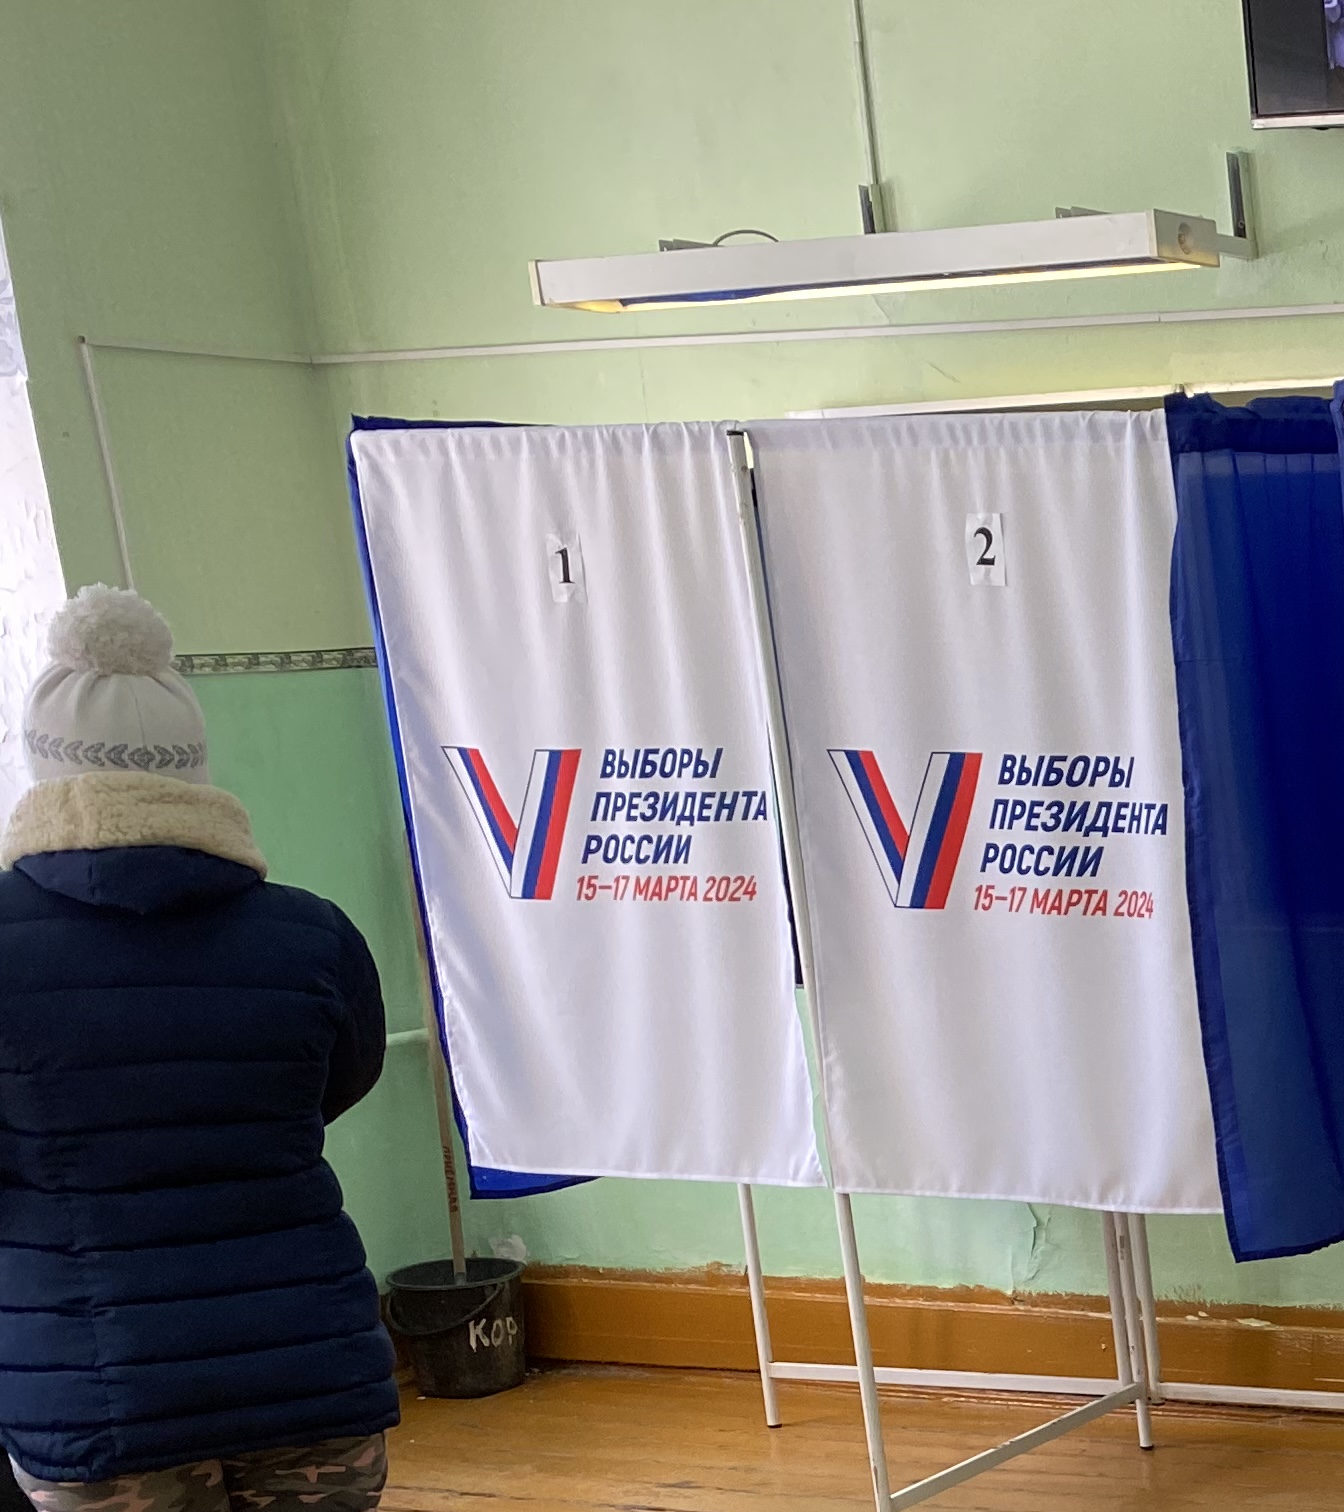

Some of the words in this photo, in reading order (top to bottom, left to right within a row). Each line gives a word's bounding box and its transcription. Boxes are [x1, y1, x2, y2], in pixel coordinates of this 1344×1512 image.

[973, 527, 997, 566] 2
[555, 547, 574, 584] 1
[600, 747, 724, 778] ВЫБОРЫ
[998, 755, 1135, 787] ВЫБОРЫ
[593, 791, 768, 824] ПРЕЗИДЕНТА
[990, 798, 1168, 837] ПРЕЗИДЕНТА
[582, 834, 692, 864] РОССИИ
[981, 843, 1103, 876] РОССИИ
[632, 875, 699, 901] МАРТА
[702, 876, 758, 902] 2024
[1030, 888, 1110, 916] МАРТА
[1112, 890, 1157, 920] 2024
